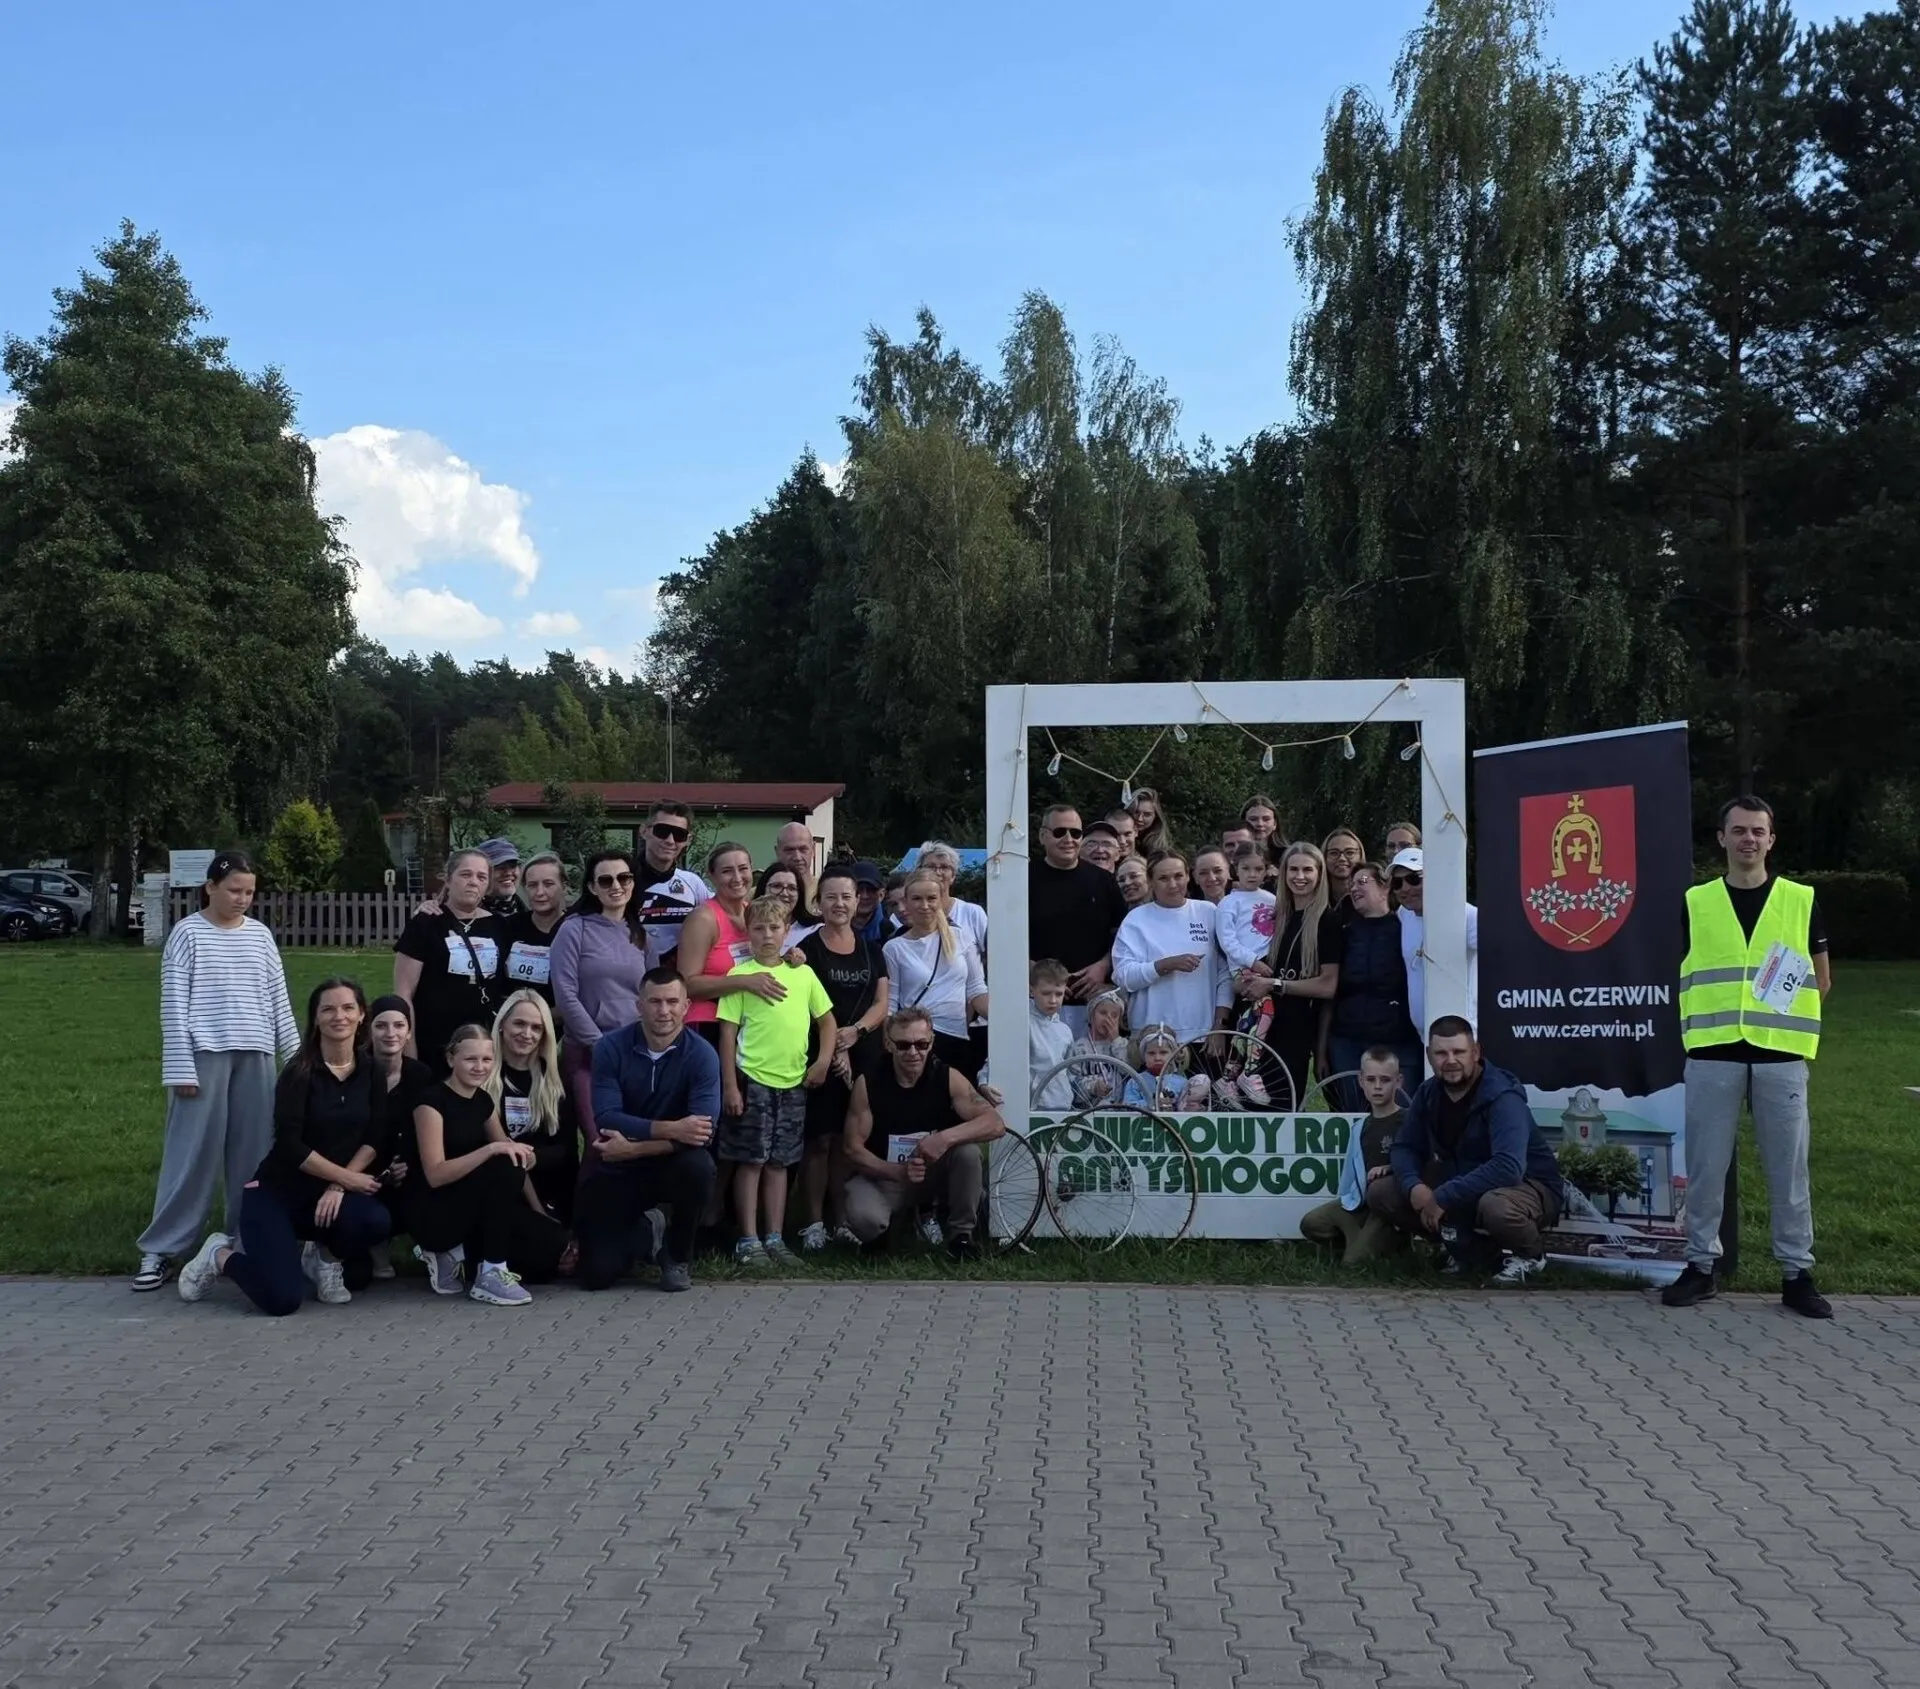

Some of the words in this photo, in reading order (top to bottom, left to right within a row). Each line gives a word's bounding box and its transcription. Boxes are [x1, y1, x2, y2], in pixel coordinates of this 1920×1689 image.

[518, 963, 534, 976] 08
[1782, 972, 1798, 993] 02
[1497, 989, 1566, 1009] GMINA
[1569, 985, 1670, 1007] CZERWIN
[1511, 1019, 1655, 1042] www.czerwin.pl
[508, 1123, 526, 1133] 37
[1029, 1115, 1286, 1154] ROWEROWY
[1294, 1116, 1363, 1154] RA
